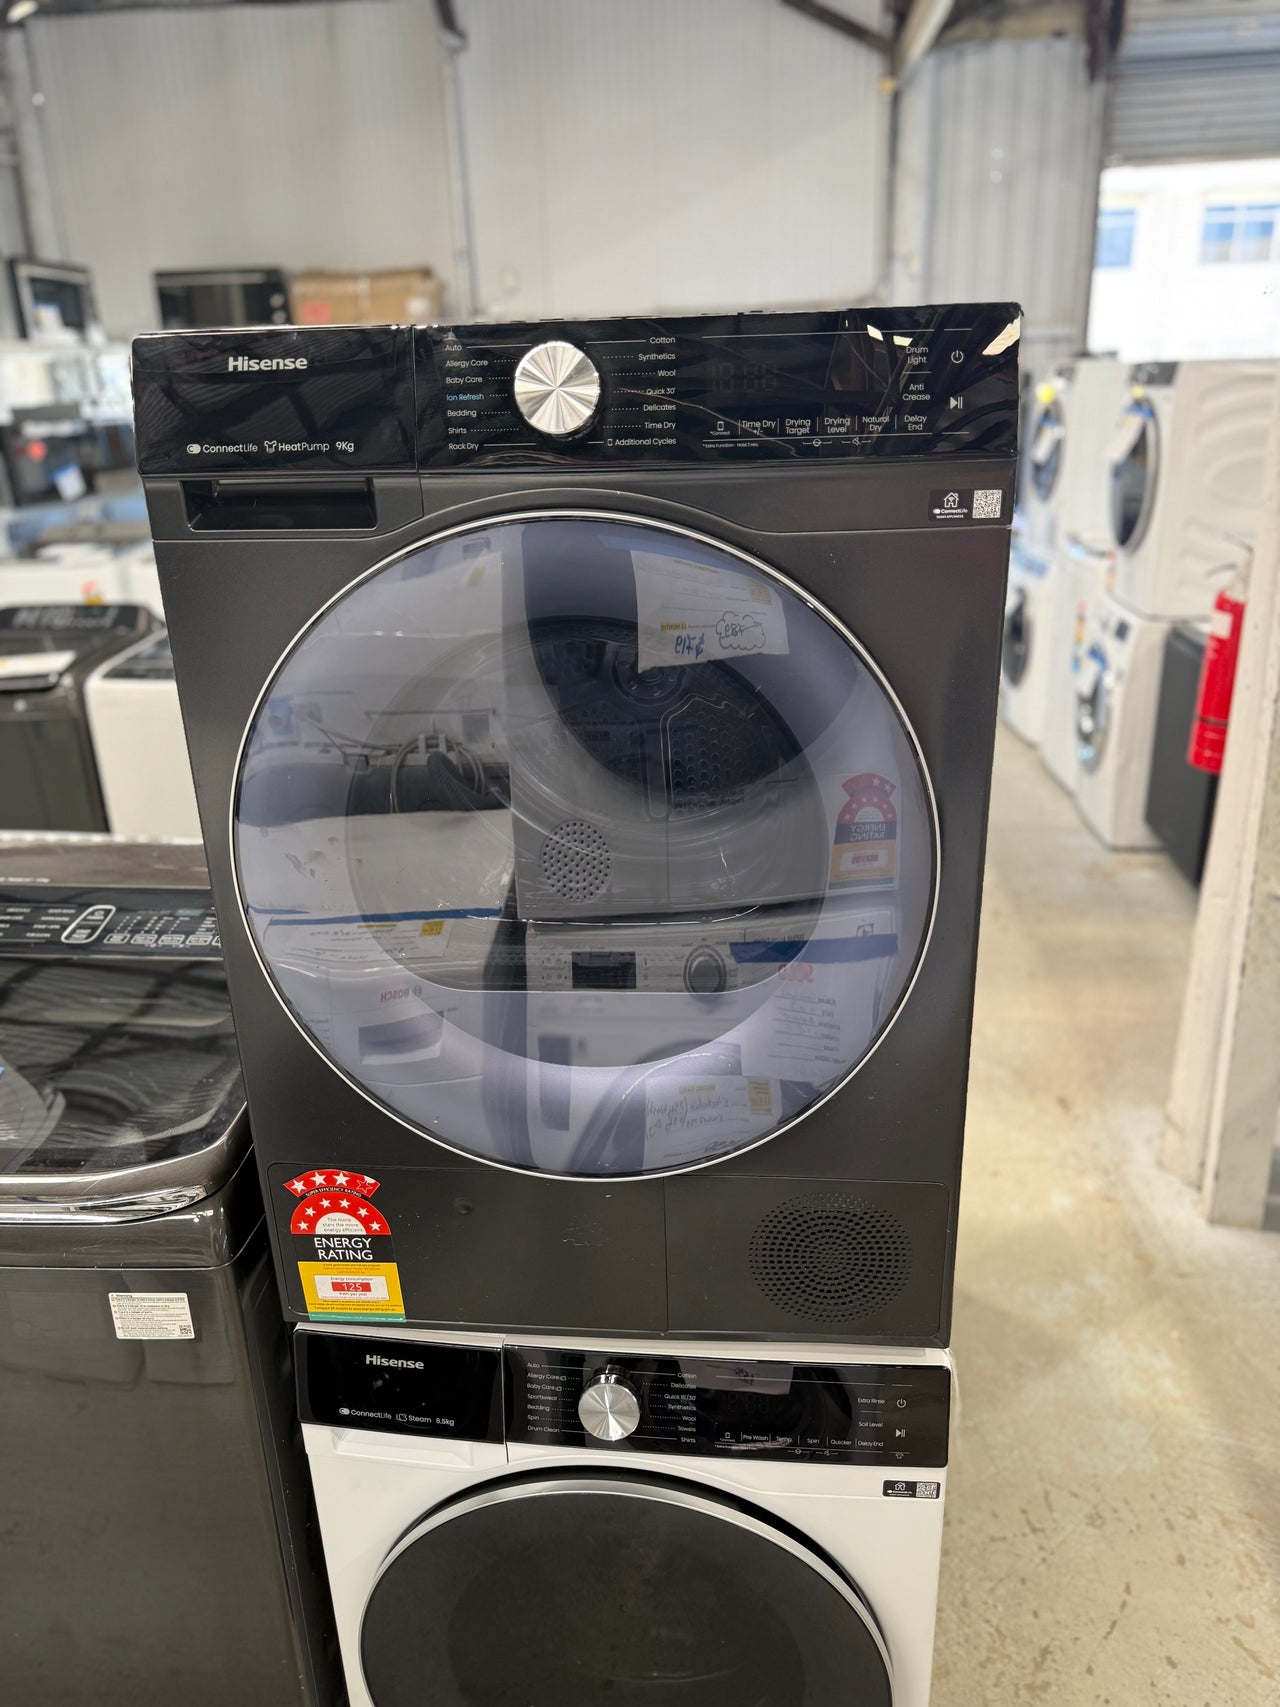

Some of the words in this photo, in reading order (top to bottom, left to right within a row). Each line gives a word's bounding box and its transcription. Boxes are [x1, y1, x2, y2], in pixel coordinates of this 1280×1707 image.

[649, 336, 676, 345] Cotton
[445, 344, 462, 352] Auto
[905, 346, 929, 354] Drum
[638, 352, 676, 362] Synthetics
[907, 355, 927, 364] Light
[227, 355, 308, 372] Hisense
[445, 359, 469, 369] Allergy
[470, 358, 488, 366] Care
[657, 369, 676, 378] Wool
[445, 376, 463, 385] Baby
[464, 375, 483, 384] Care
[646, 387, 666, 396] Quick
[908, 383, 925, 391] Anti
[459, 393, 484, 401] Refresh
[902, 393, 931, 401] Crease
[643, 403, 676, 412] Delicates
[447, 409, 477, 418] Bedding
[785, 418, 811, 428] Drying
[824, 417, 850, 427] Drying
[862, 415, 890, 424] Natural
[904, 414, 927, 424] Delay
[644, 421, 662, 430] Time
[664, 421, 676, 431] Dry
[741, 420, 761, 429] Time
[762, 420, 776, 430] Dry
[827, 425, 847, 434] Level
[869, 423, 883, 433] Dry
[907, 422, 923, 431] End
[448, 426, 467, 434] Shirts
[785, 426, 810, 436] Target
[614, 438, 652, 447] Additional
[652, 437, 677, 447] Cycles
[202, 443, 258, 454] ConnectLife
[278, 442, 330, 454] HeatPump
[335, 441, 355, 453] 9Kg
[448, 443, 465, 451] Rack
[466, 442, 479, 452] Dry
[305, 1188, 318, 1197] SUPER
[313, 1237, 372, 1249] ENERGY
[318, 1249, 373, 1261] RATING
[342, 1283, 362, 1292] 125
[365, 1354, 425, 1370] Hisense
[527, 1372, 546, 1380] Allergy
[527, 1393, 558, 1401] Sportswear
[857, 1397, 871, 1405] Extra
[527, 1404, 550, 1412] Bedding
[667, 1403, 697, 1411] Synthetics
[350, 1409, 392, 1420] ConnectLife
[408, 1415, 432, 1423] Steam
[857, 1440, 873, 1448] Delay
